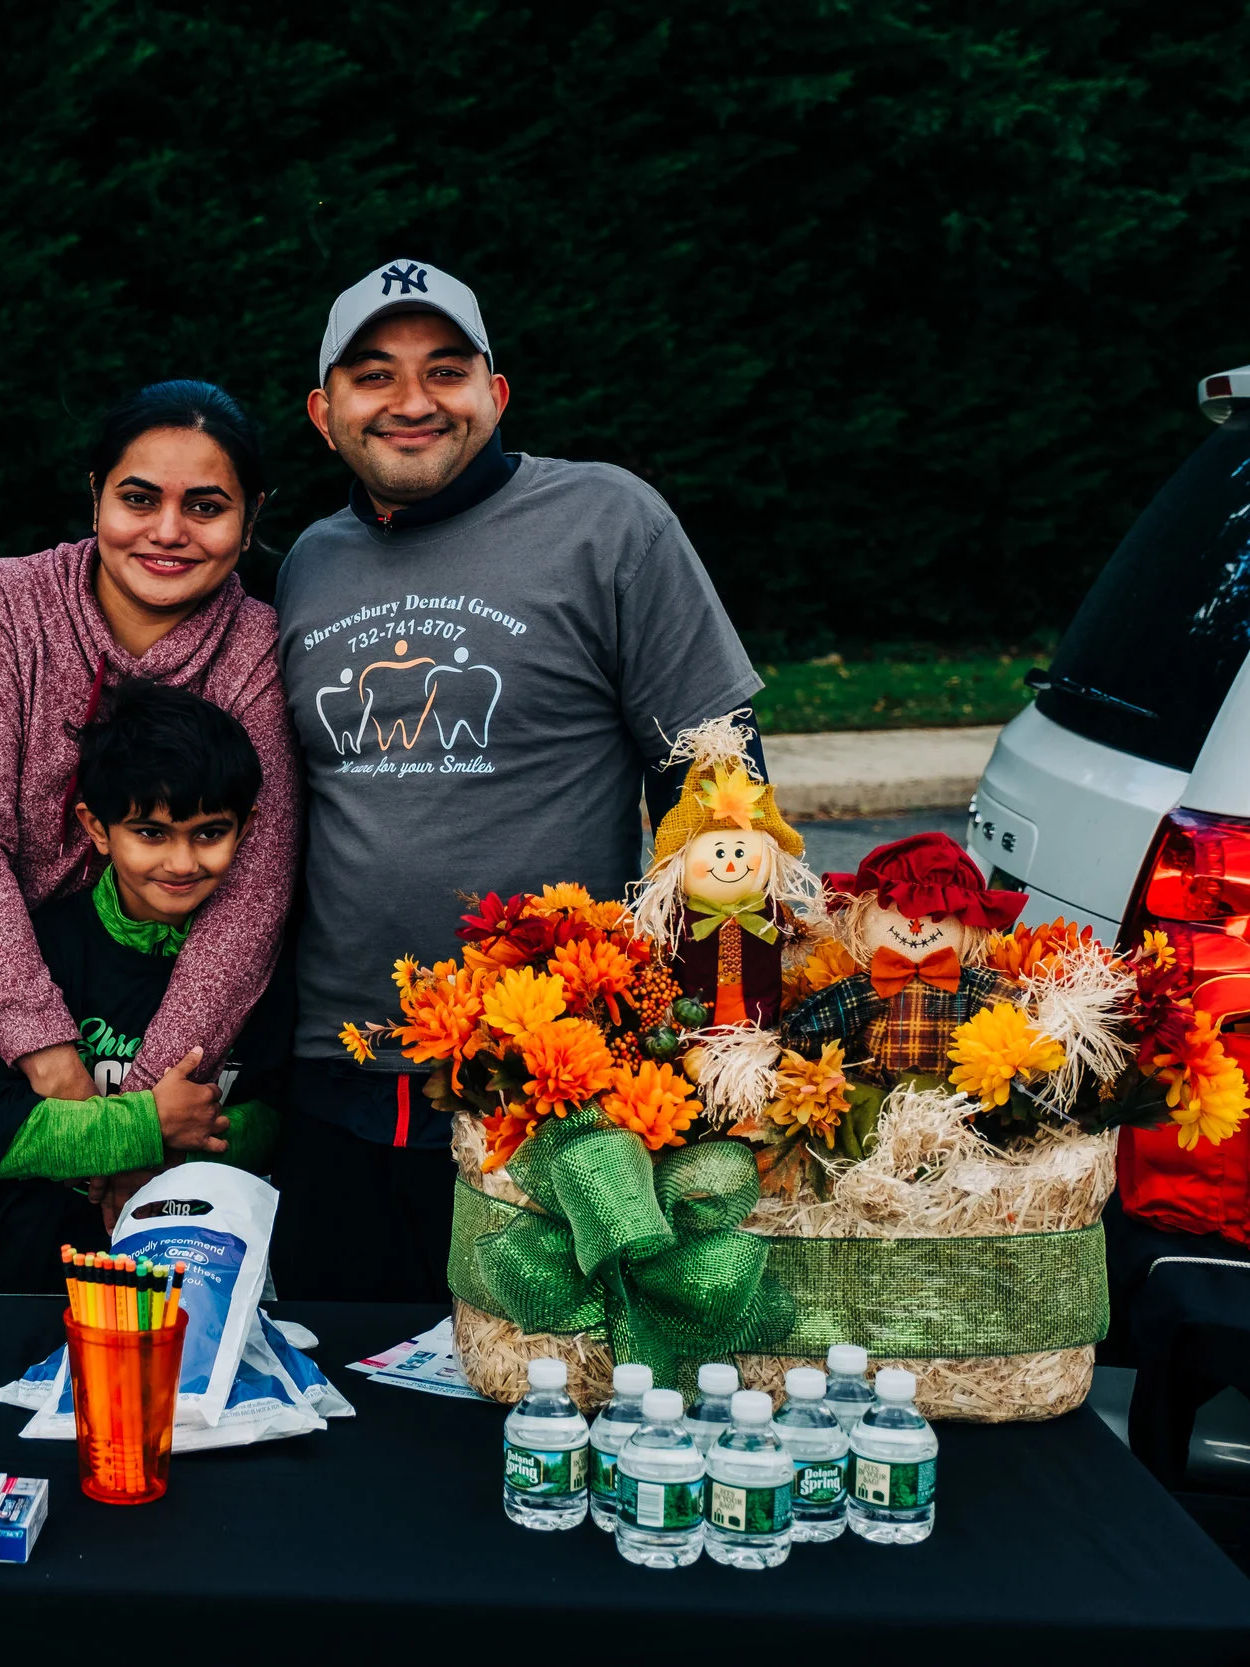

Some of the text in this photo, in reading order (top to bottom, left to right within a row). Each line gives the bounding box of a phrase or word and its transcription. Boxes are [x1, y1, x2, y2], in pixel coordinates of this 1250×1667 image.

[381, 263, 428, 296] NY
[303, 594, 527, 651] Shrewsbury Dental Group
[347, 618, 466, 654] 732-741-8707
[372, 755, 396, 778] for
[397, 761, 435, 779] your
[439, 754, 496, 775] Smiles
[161, 1199, 191, 1216] 2018
[160, 1238, 226, 1256] recommend
[168, 1248, 207, 1262] Oral-B
[193, 1265, 222, 1283] these
[507, 1449, 534, 1466] Poland
[506, 1460, 538, 1484] Spring
[804, 1467, 838, 1480] Poland
[800, 1478, 841, 1496] Spring
